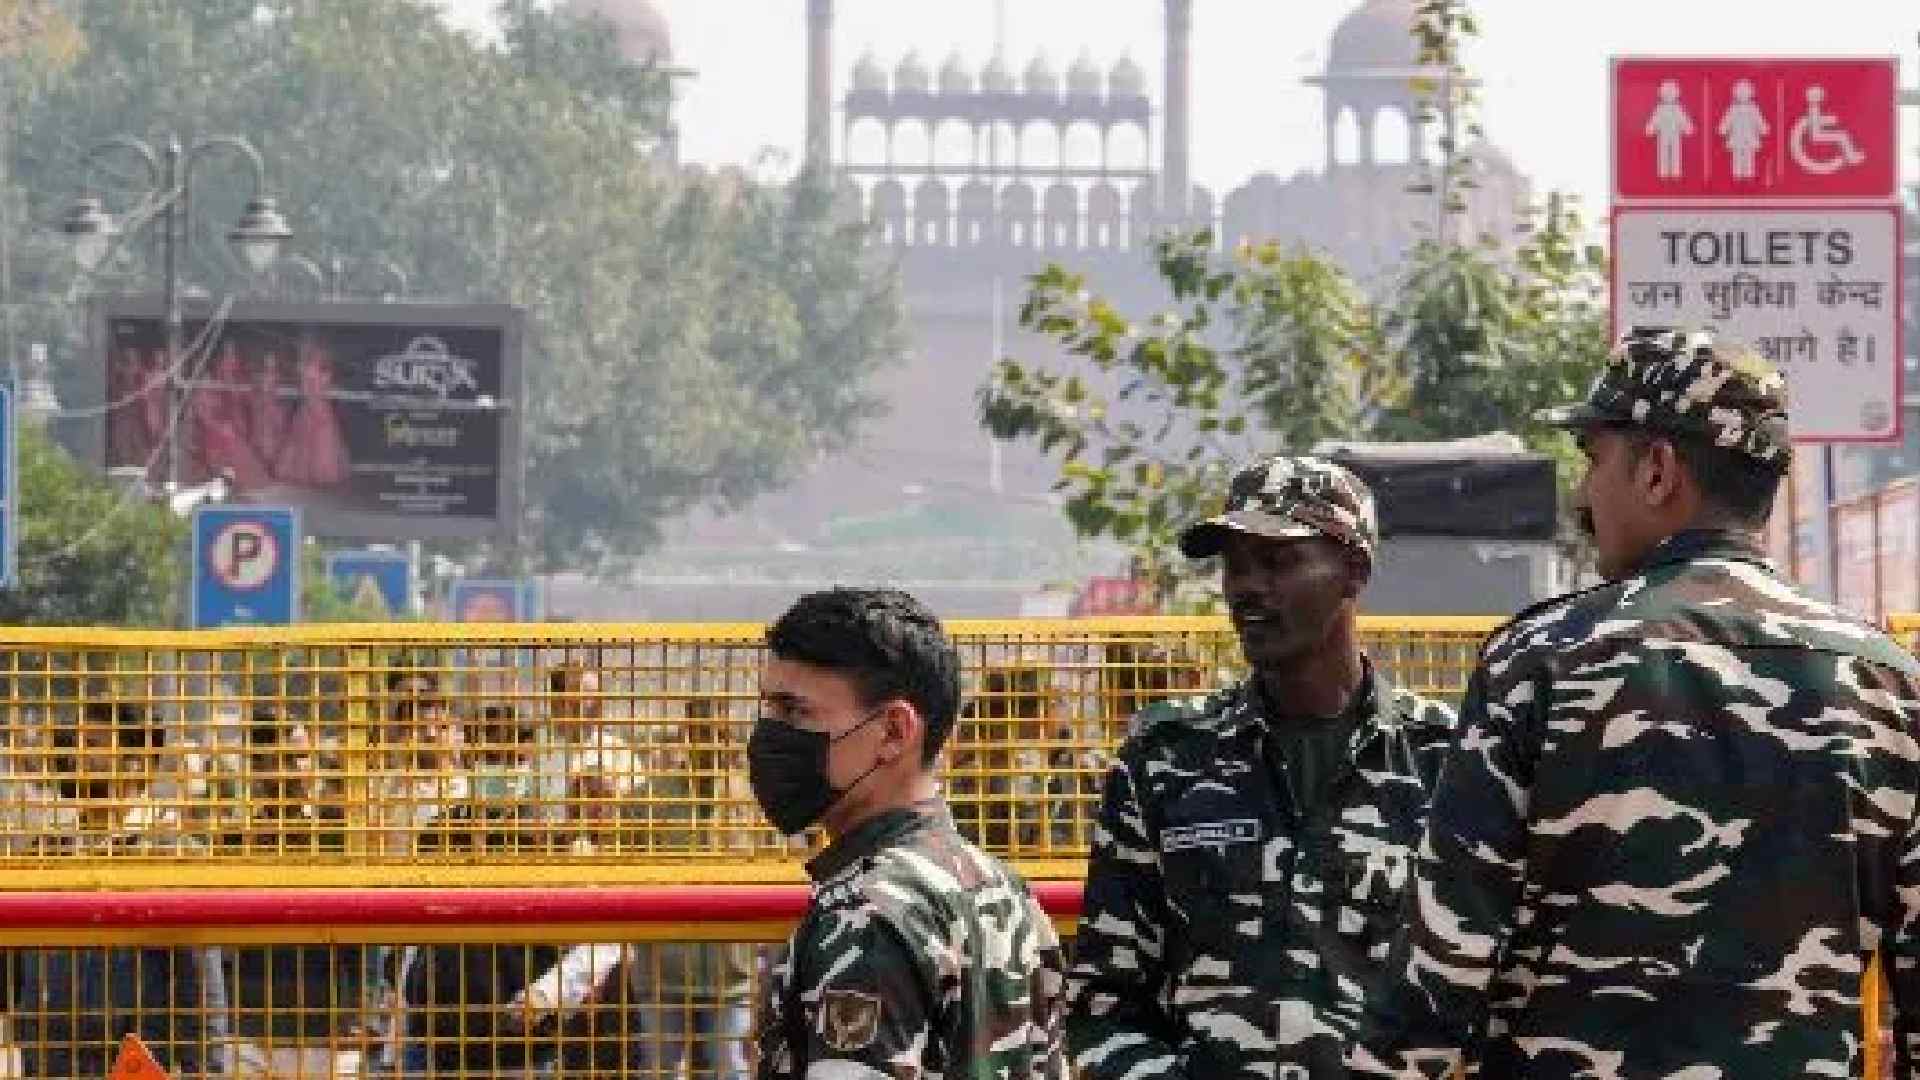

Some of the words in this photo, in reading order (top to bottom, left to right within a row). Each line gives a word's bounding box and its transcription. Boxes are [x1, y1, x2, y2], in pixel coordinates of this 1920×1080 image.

[1660, 230, 1854, 265] TOILETS
[1628, 281, 1682, 309] जन
[1702, 272, 1797, 320] सुविधा
[232, 531, 262, 577] P
